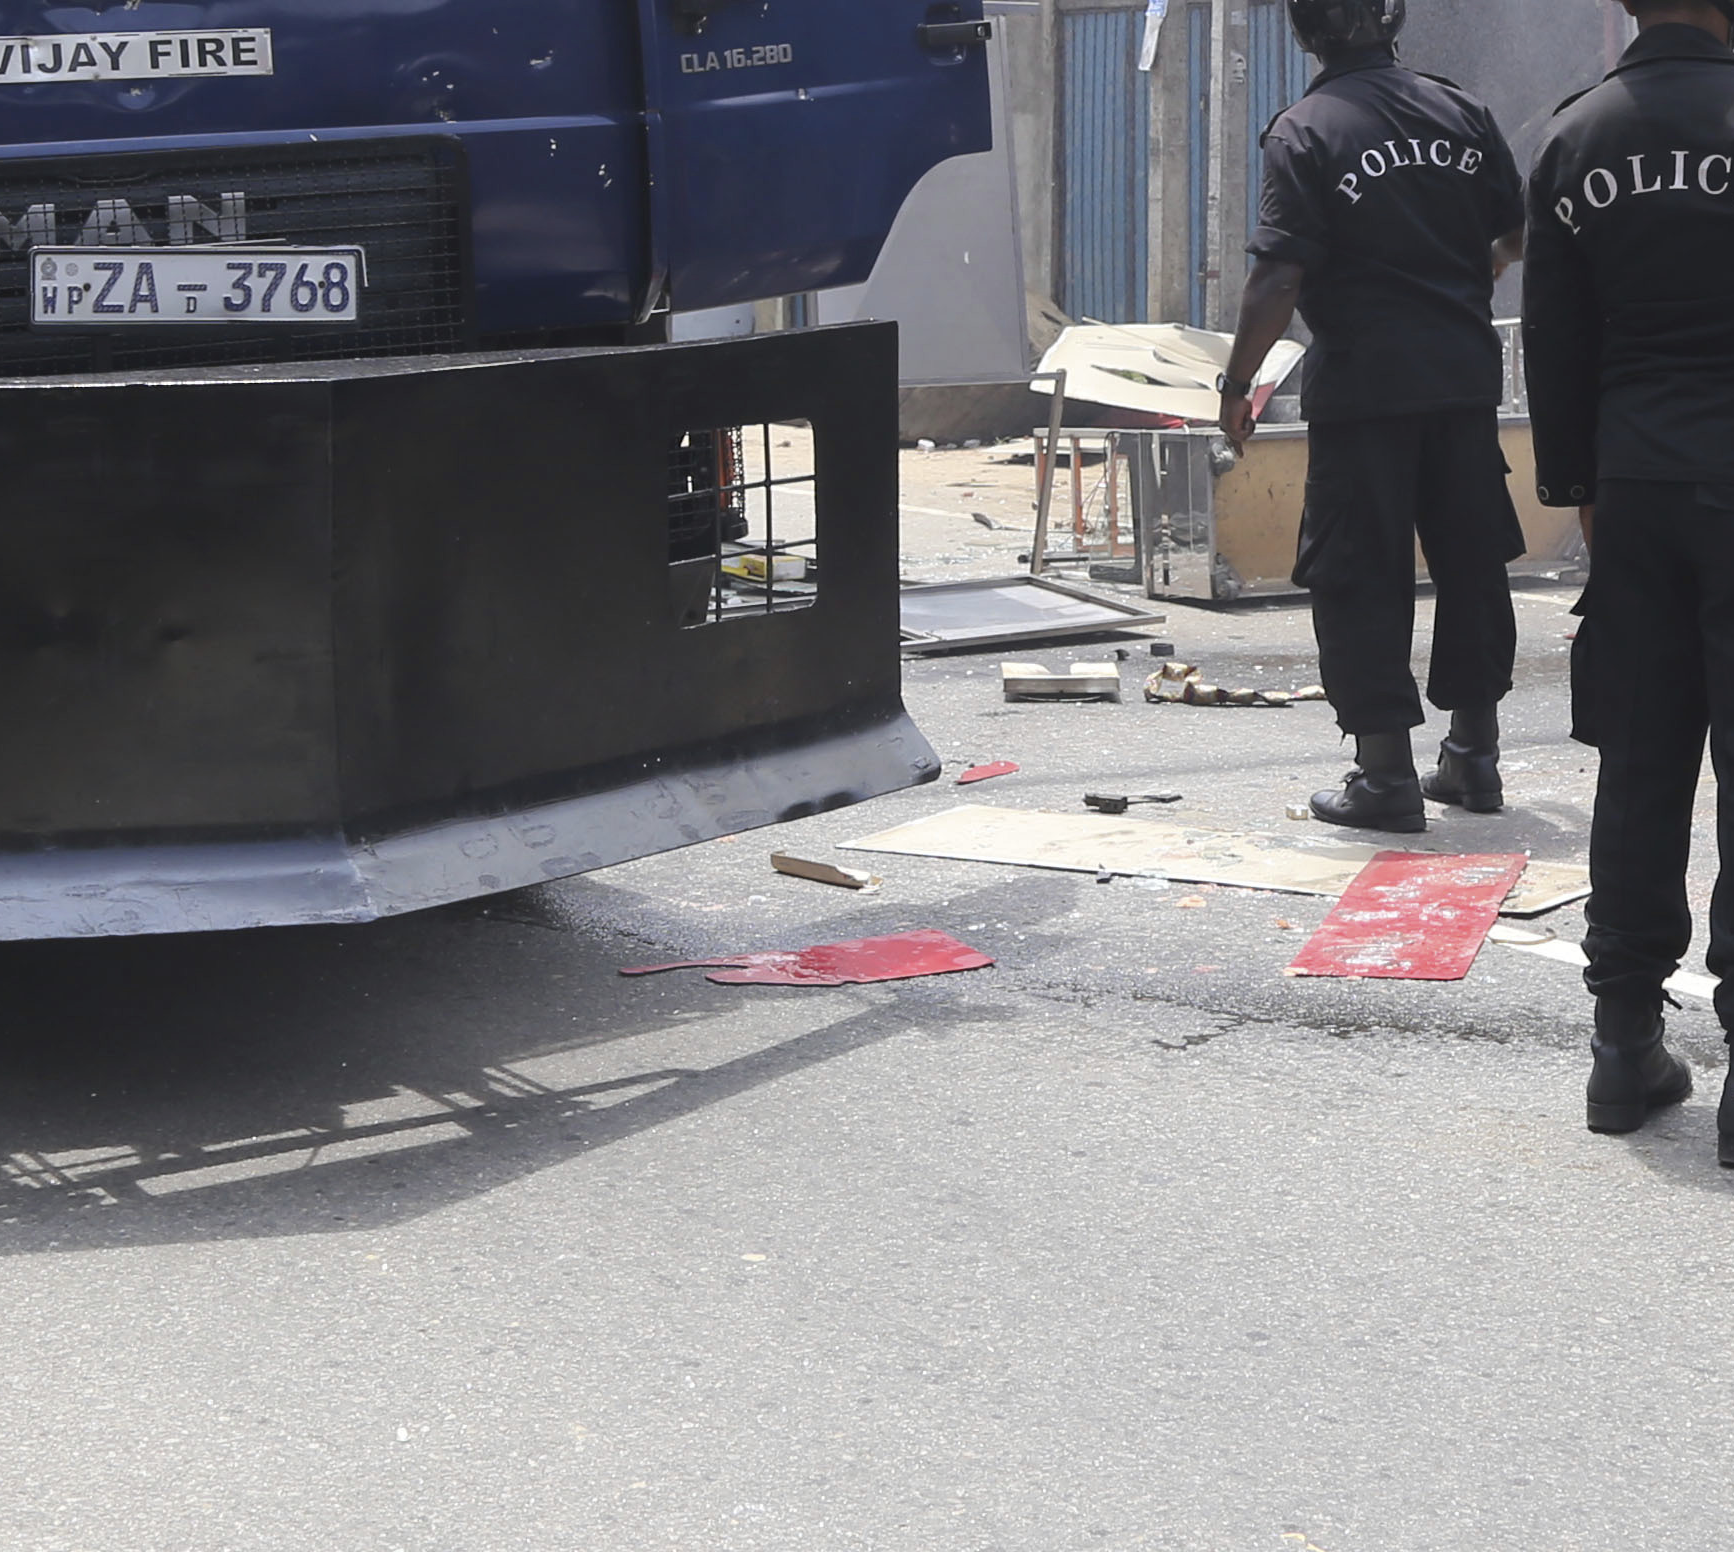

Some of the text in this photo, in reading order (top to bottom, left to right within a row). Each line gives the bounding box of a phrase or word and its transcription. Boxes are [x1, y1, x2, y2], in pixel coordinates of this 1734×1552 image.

[148, 37, 258, 69] FIRE
[681, 43, 792, 73] CLA 16.280
[1337, 138, 1483, 204] POLICE
